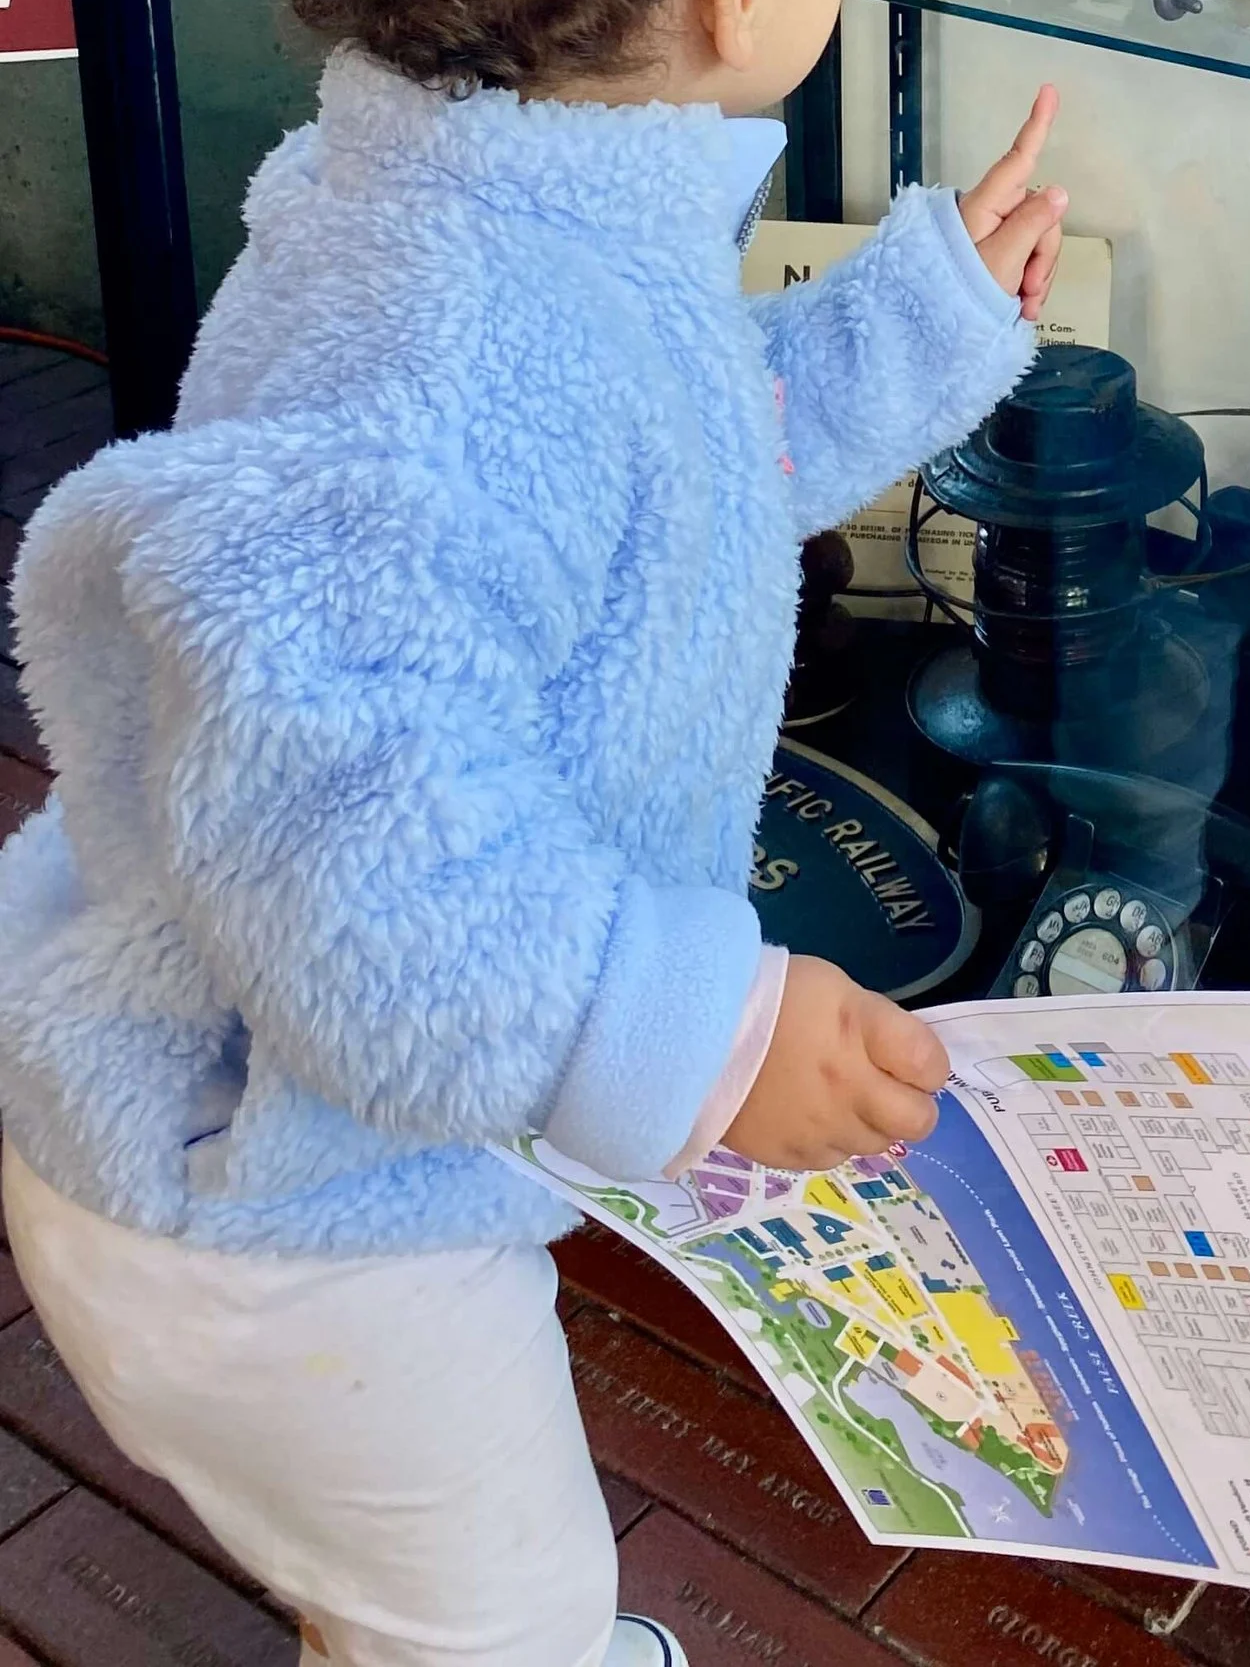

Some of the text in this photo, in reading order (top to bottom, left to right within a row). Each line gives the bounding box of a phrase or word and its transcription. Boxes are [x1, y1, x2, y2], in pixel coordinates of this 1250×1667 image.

[764, 772, 936, 930] IFIC RAILWAY
[1102, 952, 1120, 966] 604
